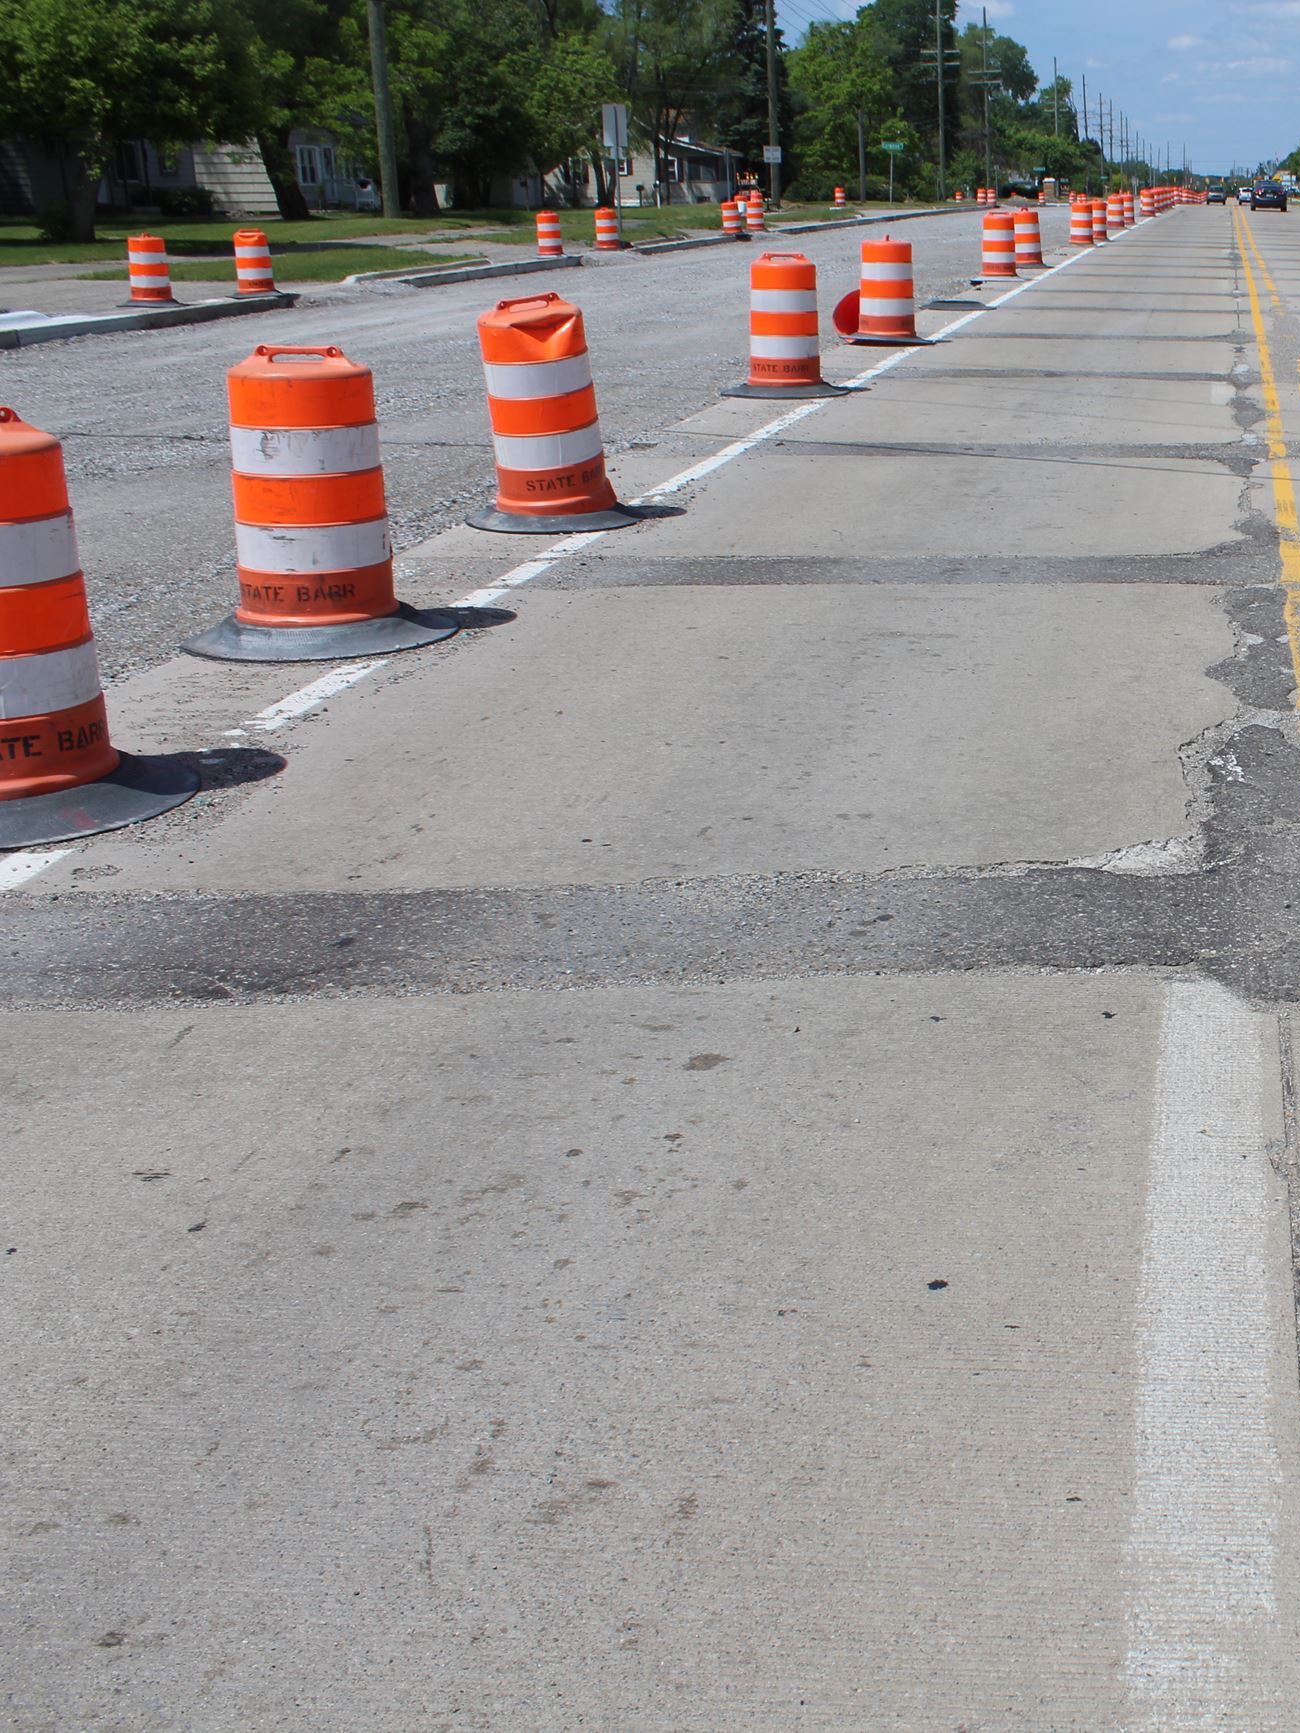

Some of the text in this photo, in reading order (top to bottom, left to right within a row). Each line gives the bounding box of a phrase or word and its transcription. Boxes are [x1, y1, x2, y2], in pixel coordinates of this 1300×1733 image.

[753, 362, 778, 373] STATE
[526, 473, 577, 492] STATE
[296, 583, 356, 602] BARR
[0, 735, 43, 760] TE
